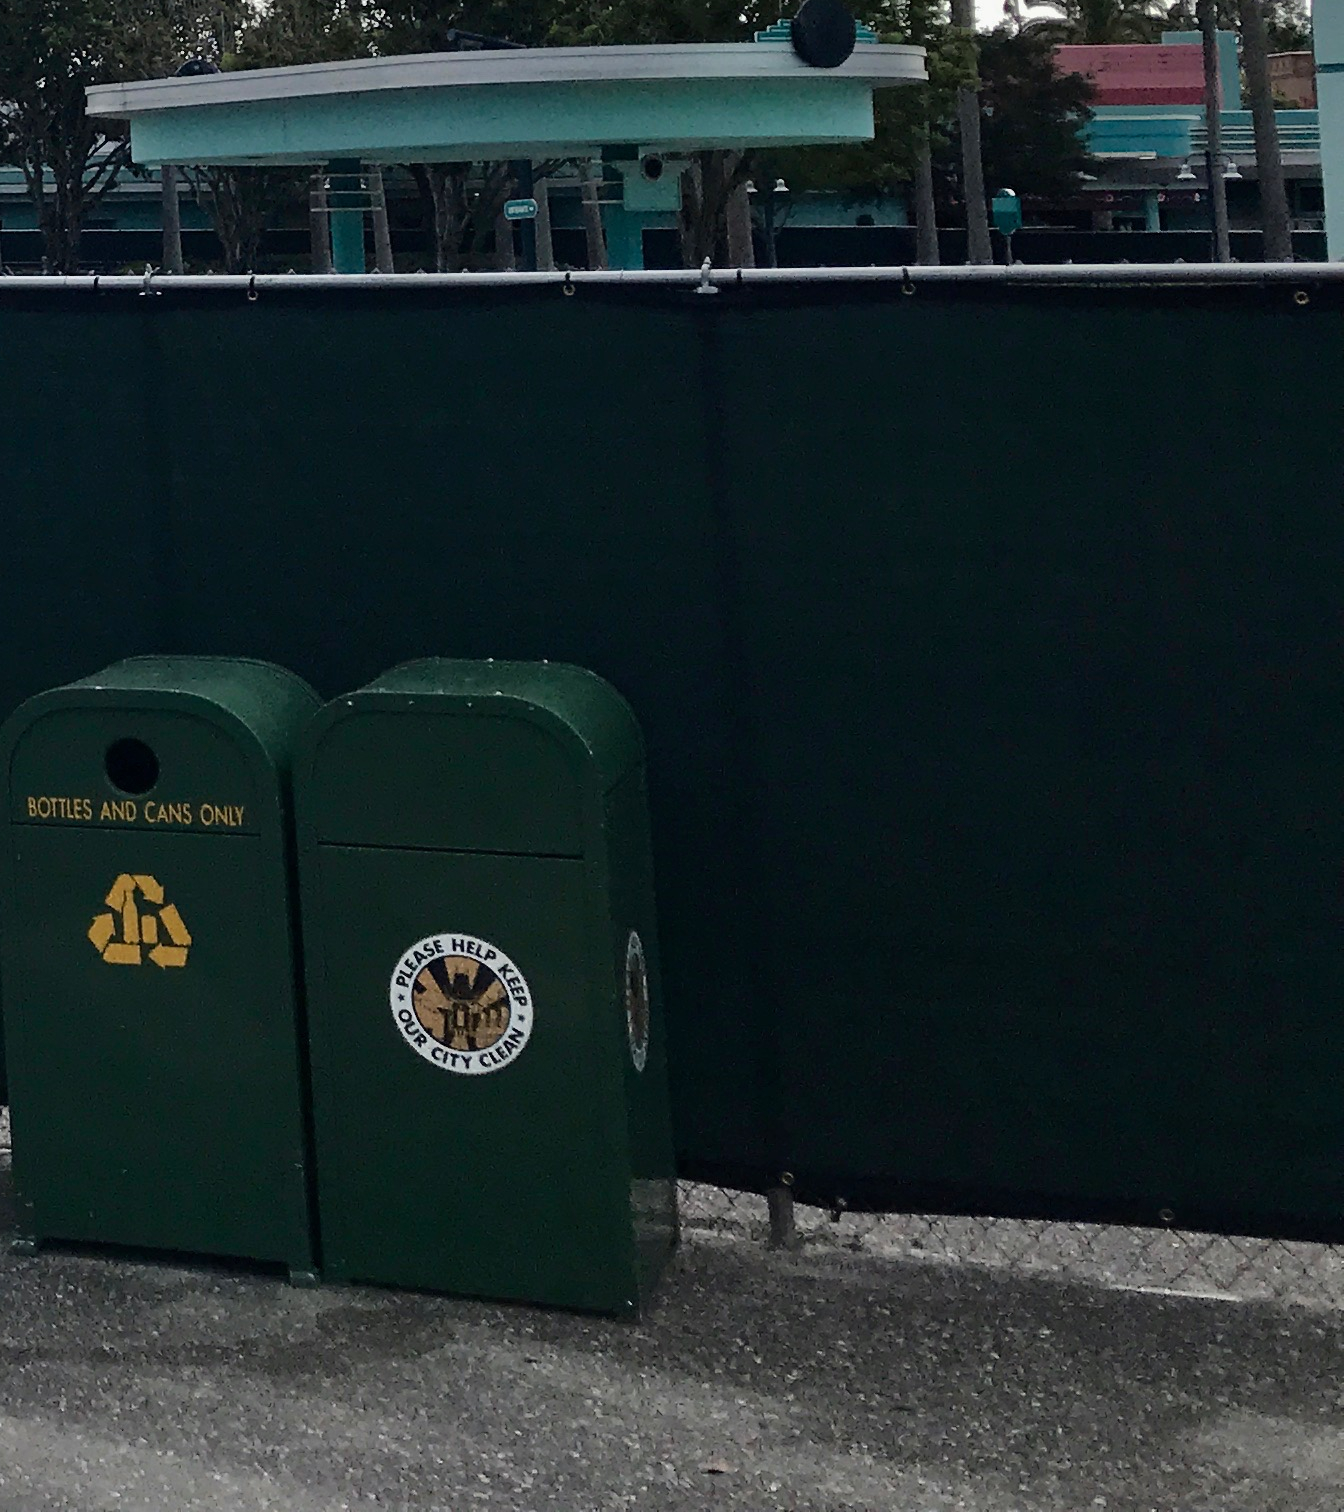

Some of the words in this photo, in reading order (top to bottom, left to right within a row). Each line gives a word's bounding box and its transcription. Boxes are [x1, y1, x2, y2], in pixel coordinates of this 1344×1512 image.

[27, 796, 93, 820] BOTTLES
[100, 801, 137, 822] AND
[144, 801, 192, 825] CANS
[200, 803, 244, 826] ONLY
[395, 939, 444, 988] PLEASE
[452, 938, 497, 961] HELP
[498, 963, 528, 1007] KEEP
[398, 1009, 427, 1048] OUR
[431, 1046, 472, 1069] CITY
[479, 1027, 525, 1068] CLEAN
